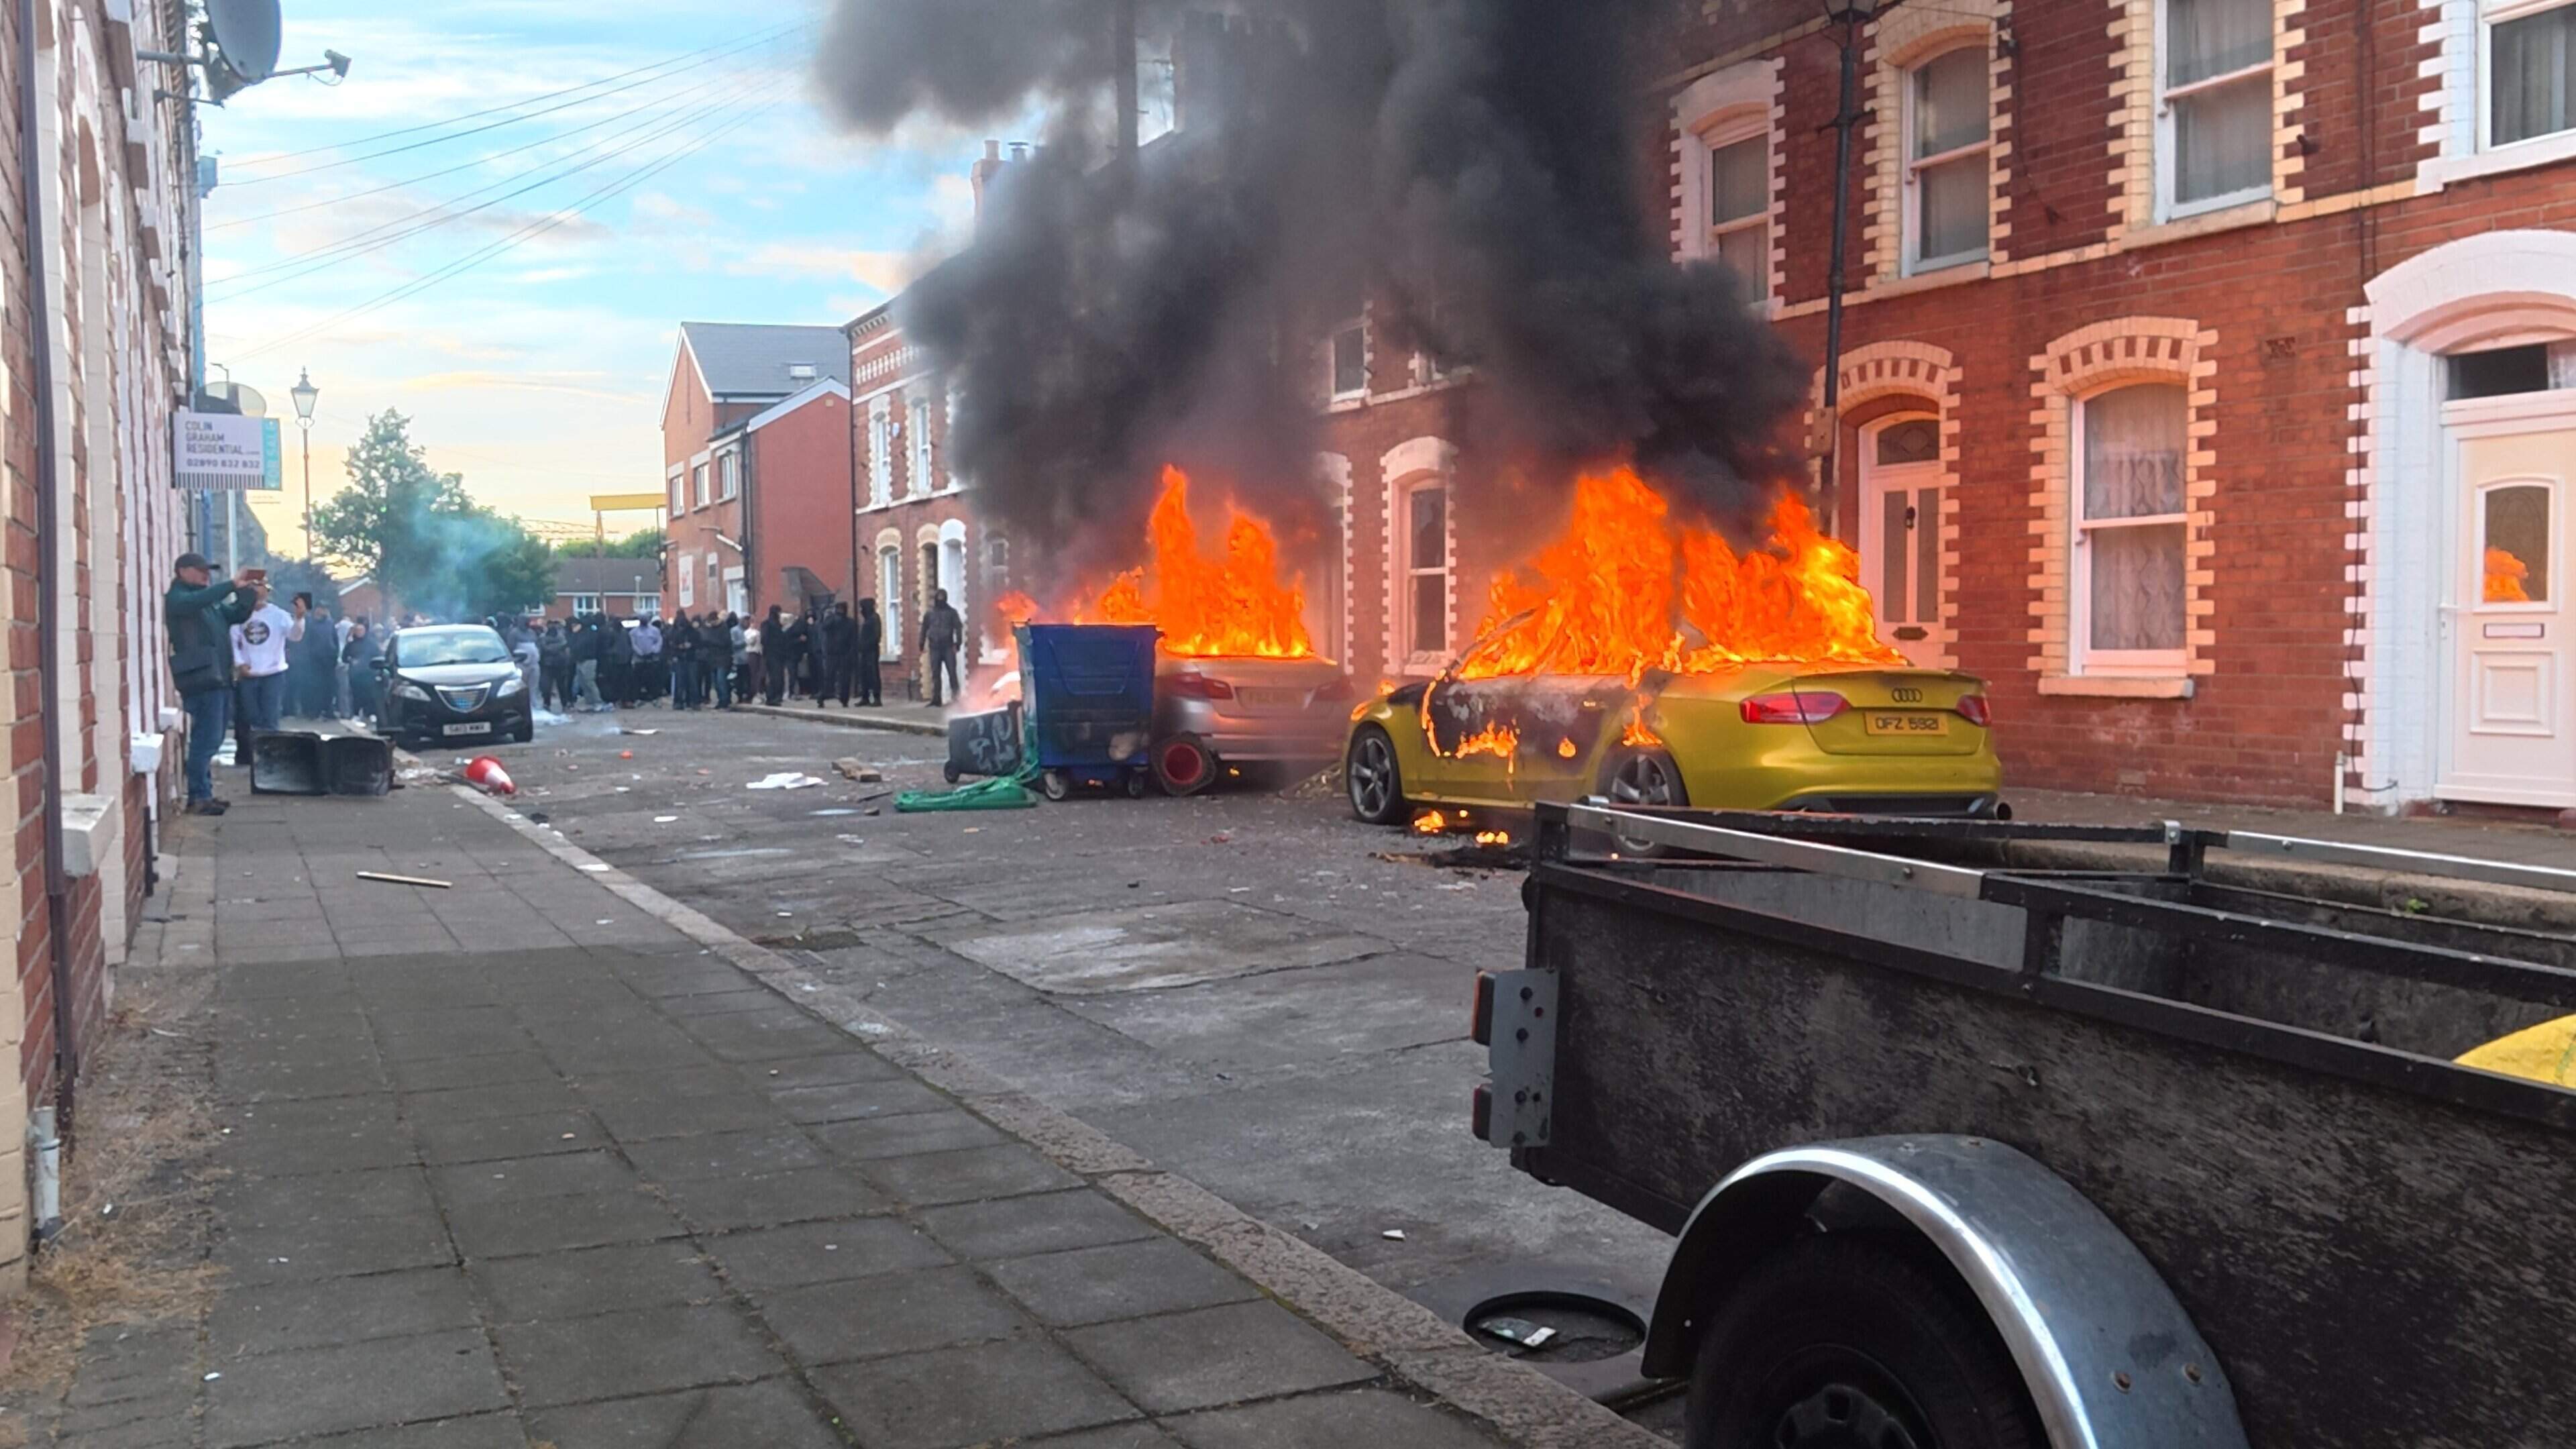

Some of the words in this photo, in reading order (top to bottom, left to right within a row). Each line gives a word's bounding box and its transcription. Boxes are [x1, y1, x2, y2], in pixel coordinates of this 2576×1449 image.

[185, 421, 212, 431] COLIN
[186, 433, 224, 442] GRAHAM
[186, 458, 218, 467] 02890
[1876, 716, 1904, 730] OFZ
